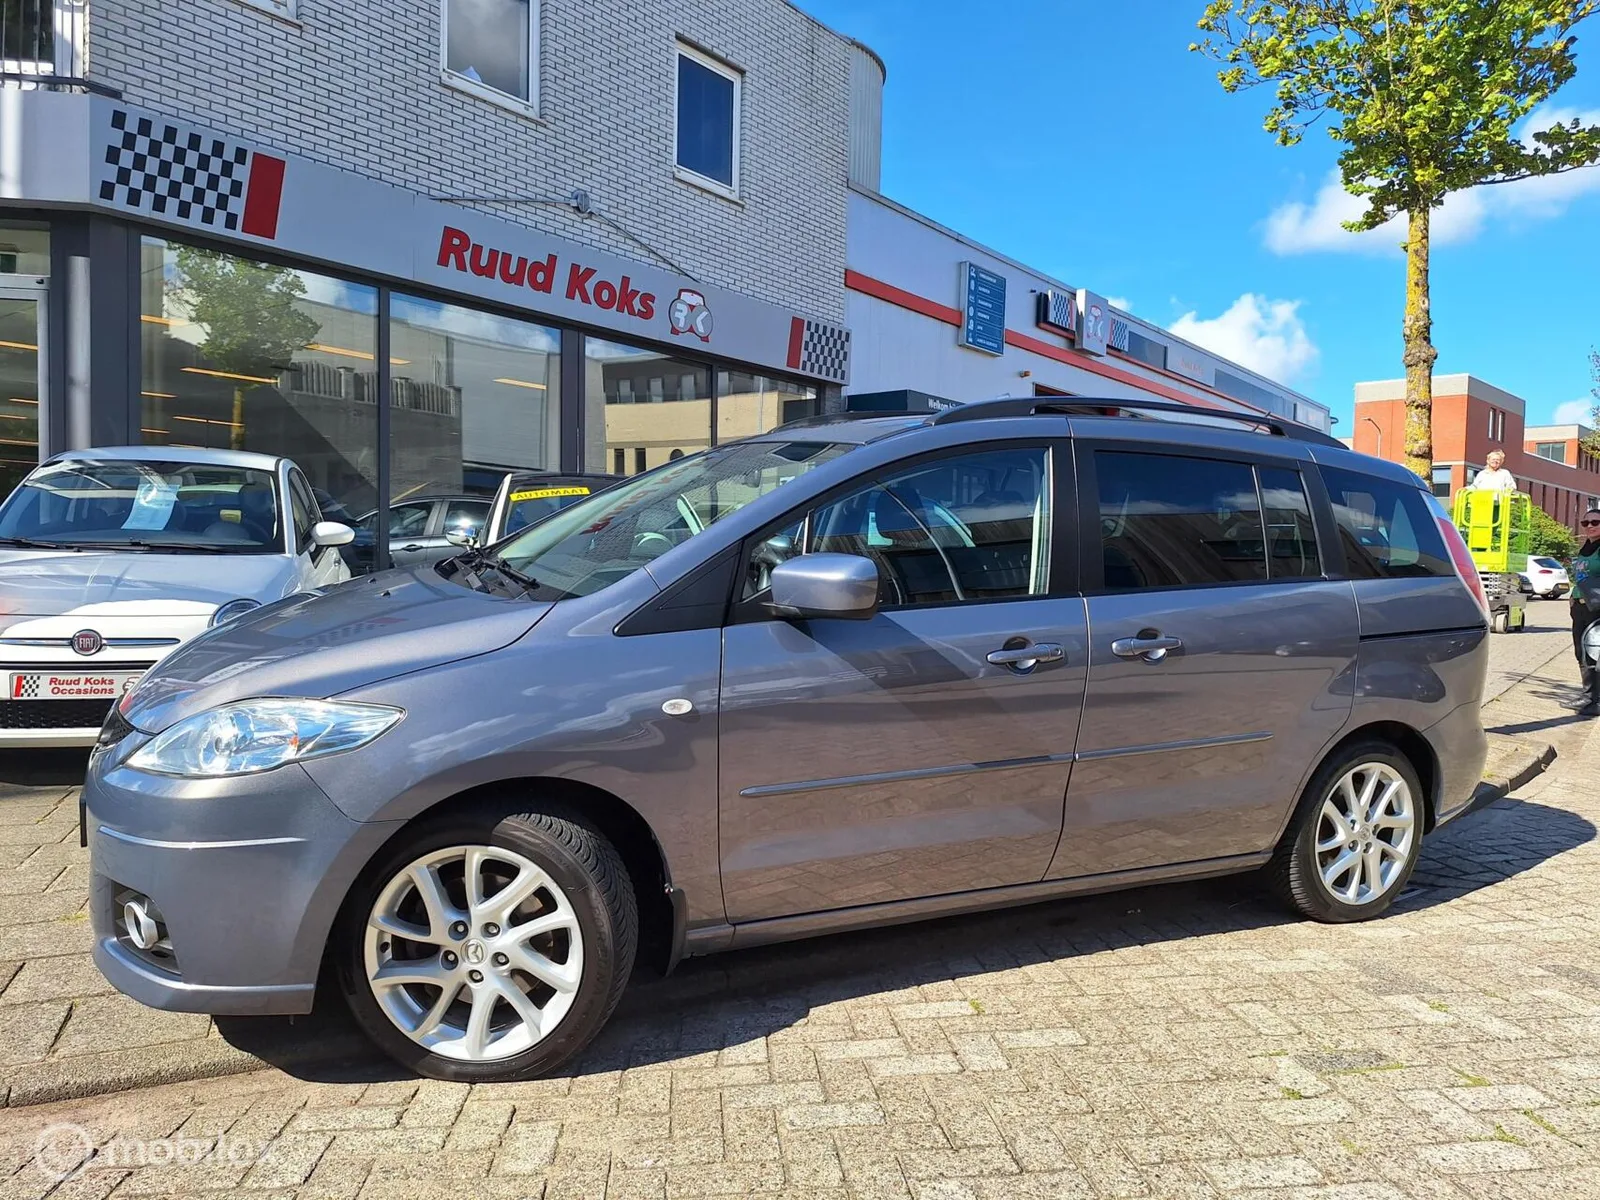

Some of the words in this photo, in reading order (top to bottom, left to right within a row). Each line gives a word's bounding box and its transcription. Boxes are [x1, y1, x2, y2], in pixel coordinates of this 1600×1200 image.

[437, 225, 557, 294] Ruud
[565, 263, 656, 320] Koks
[515, 487, 585, 500] AUTOMAAT
[79, 637, 95, 649] FIAT
[49, 677, 82, 686] Ruud
[83, 677, 115, 686] Koks
[51, 686, 115, 695] Occasions
